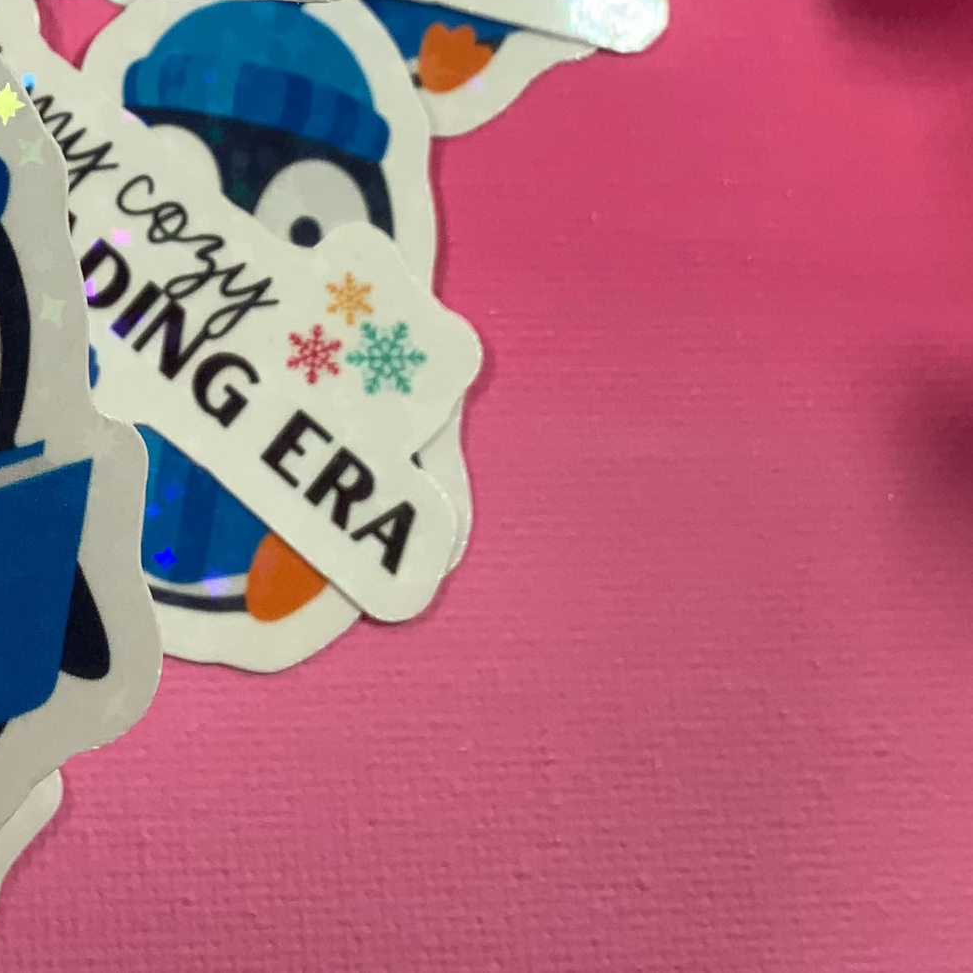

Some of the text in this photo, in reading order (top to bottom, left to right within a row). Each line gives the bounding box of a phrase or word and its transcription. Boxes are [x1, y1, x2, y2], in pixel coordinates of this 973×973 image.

[116, 173, 279, 339] cozy
[75, 235, 419, 575] DING ERA
